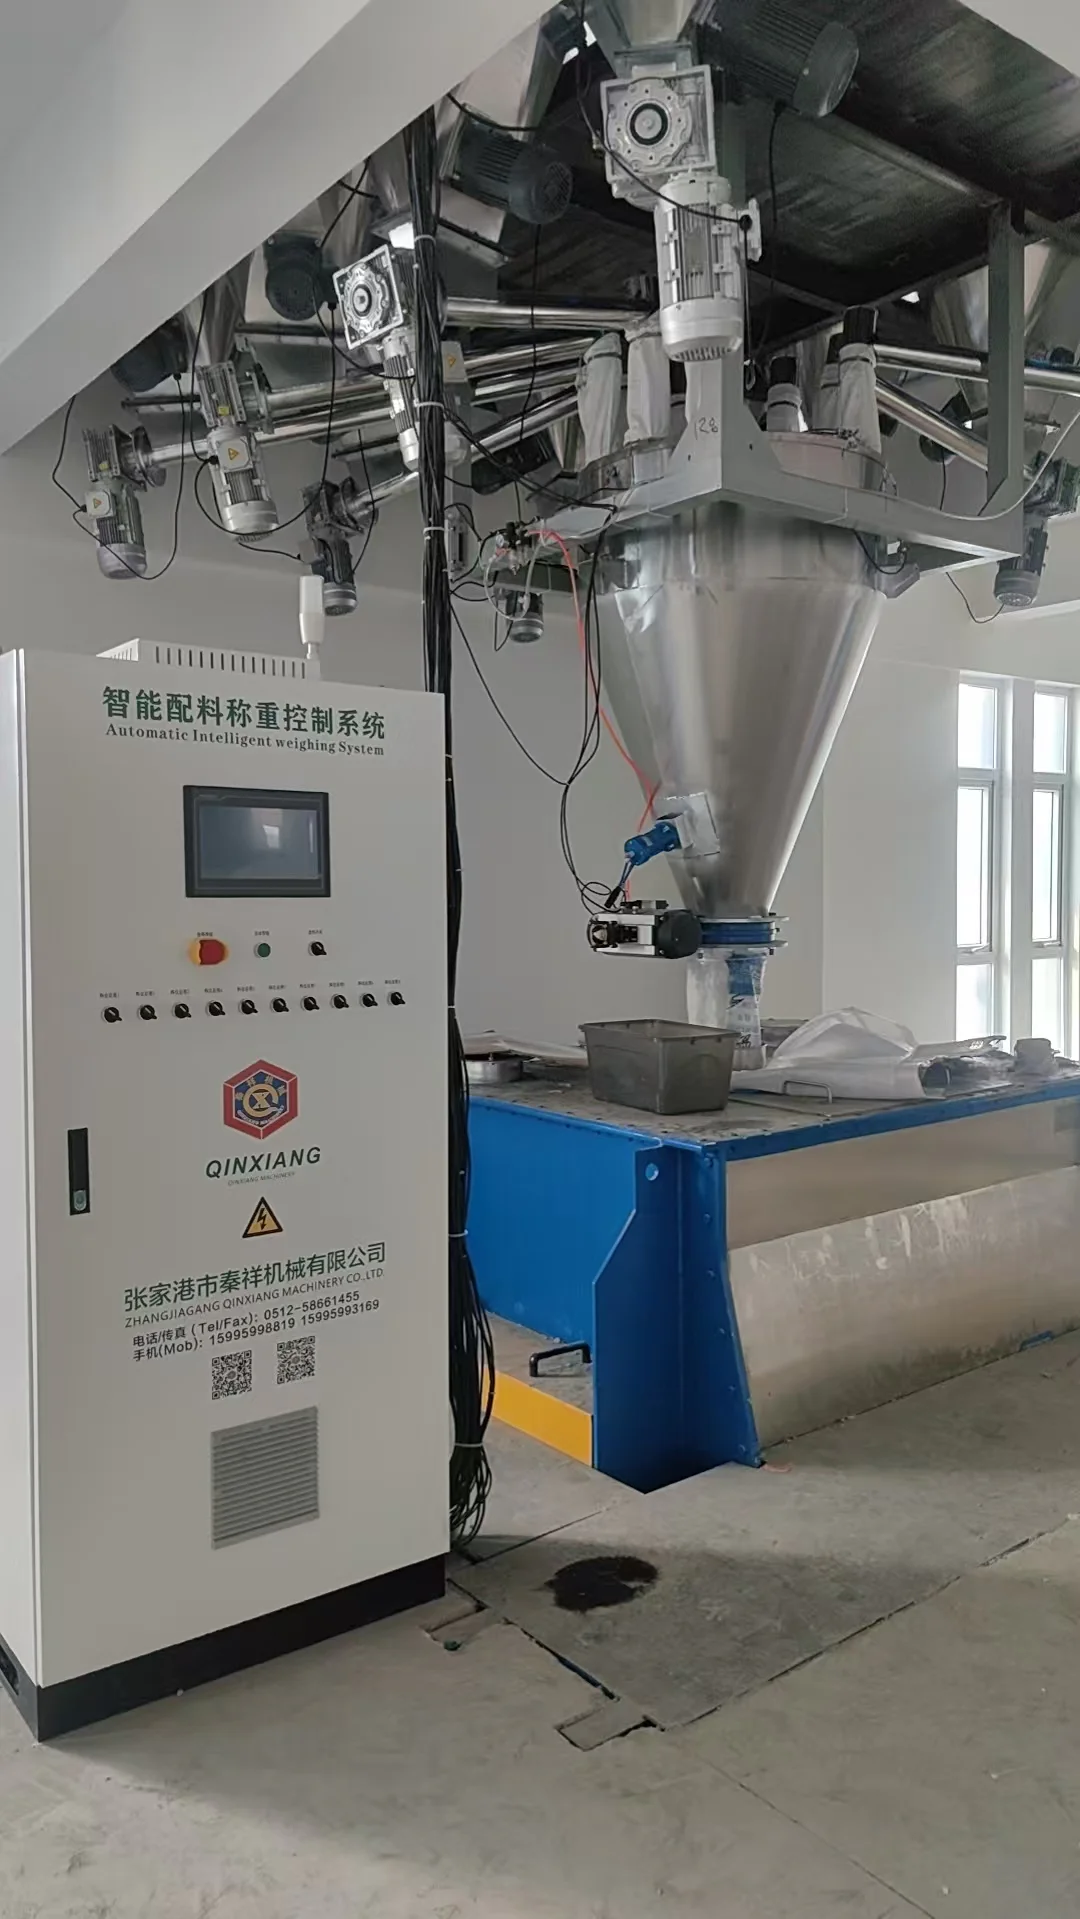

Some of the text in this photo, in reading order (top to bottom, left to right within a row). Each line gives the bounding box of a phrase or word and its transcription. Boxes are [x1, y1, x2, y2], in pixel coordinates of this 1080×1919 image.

[102, 686, 385, 739] 智能配料称重控制系统
[105, 723, 384, 756] Automatic Intelligent weighing System
[206, 1147, 321, 1179] QINXIANG
[124, 1242, 386, 1313] 张家港市秦祥机械有限公司
[125, 1300, 220, 1328] ZHANGJIAGANG
[222, 1289, 280, 1310] QINXIANG
[282, 1276, 345, 1297] MACHINERY
[209, 1317, 296, 1346] 15995998819
[301, 1299, 380, 1326] 15995993169
[264, 1290, 360, 1320] 0512-58661455
